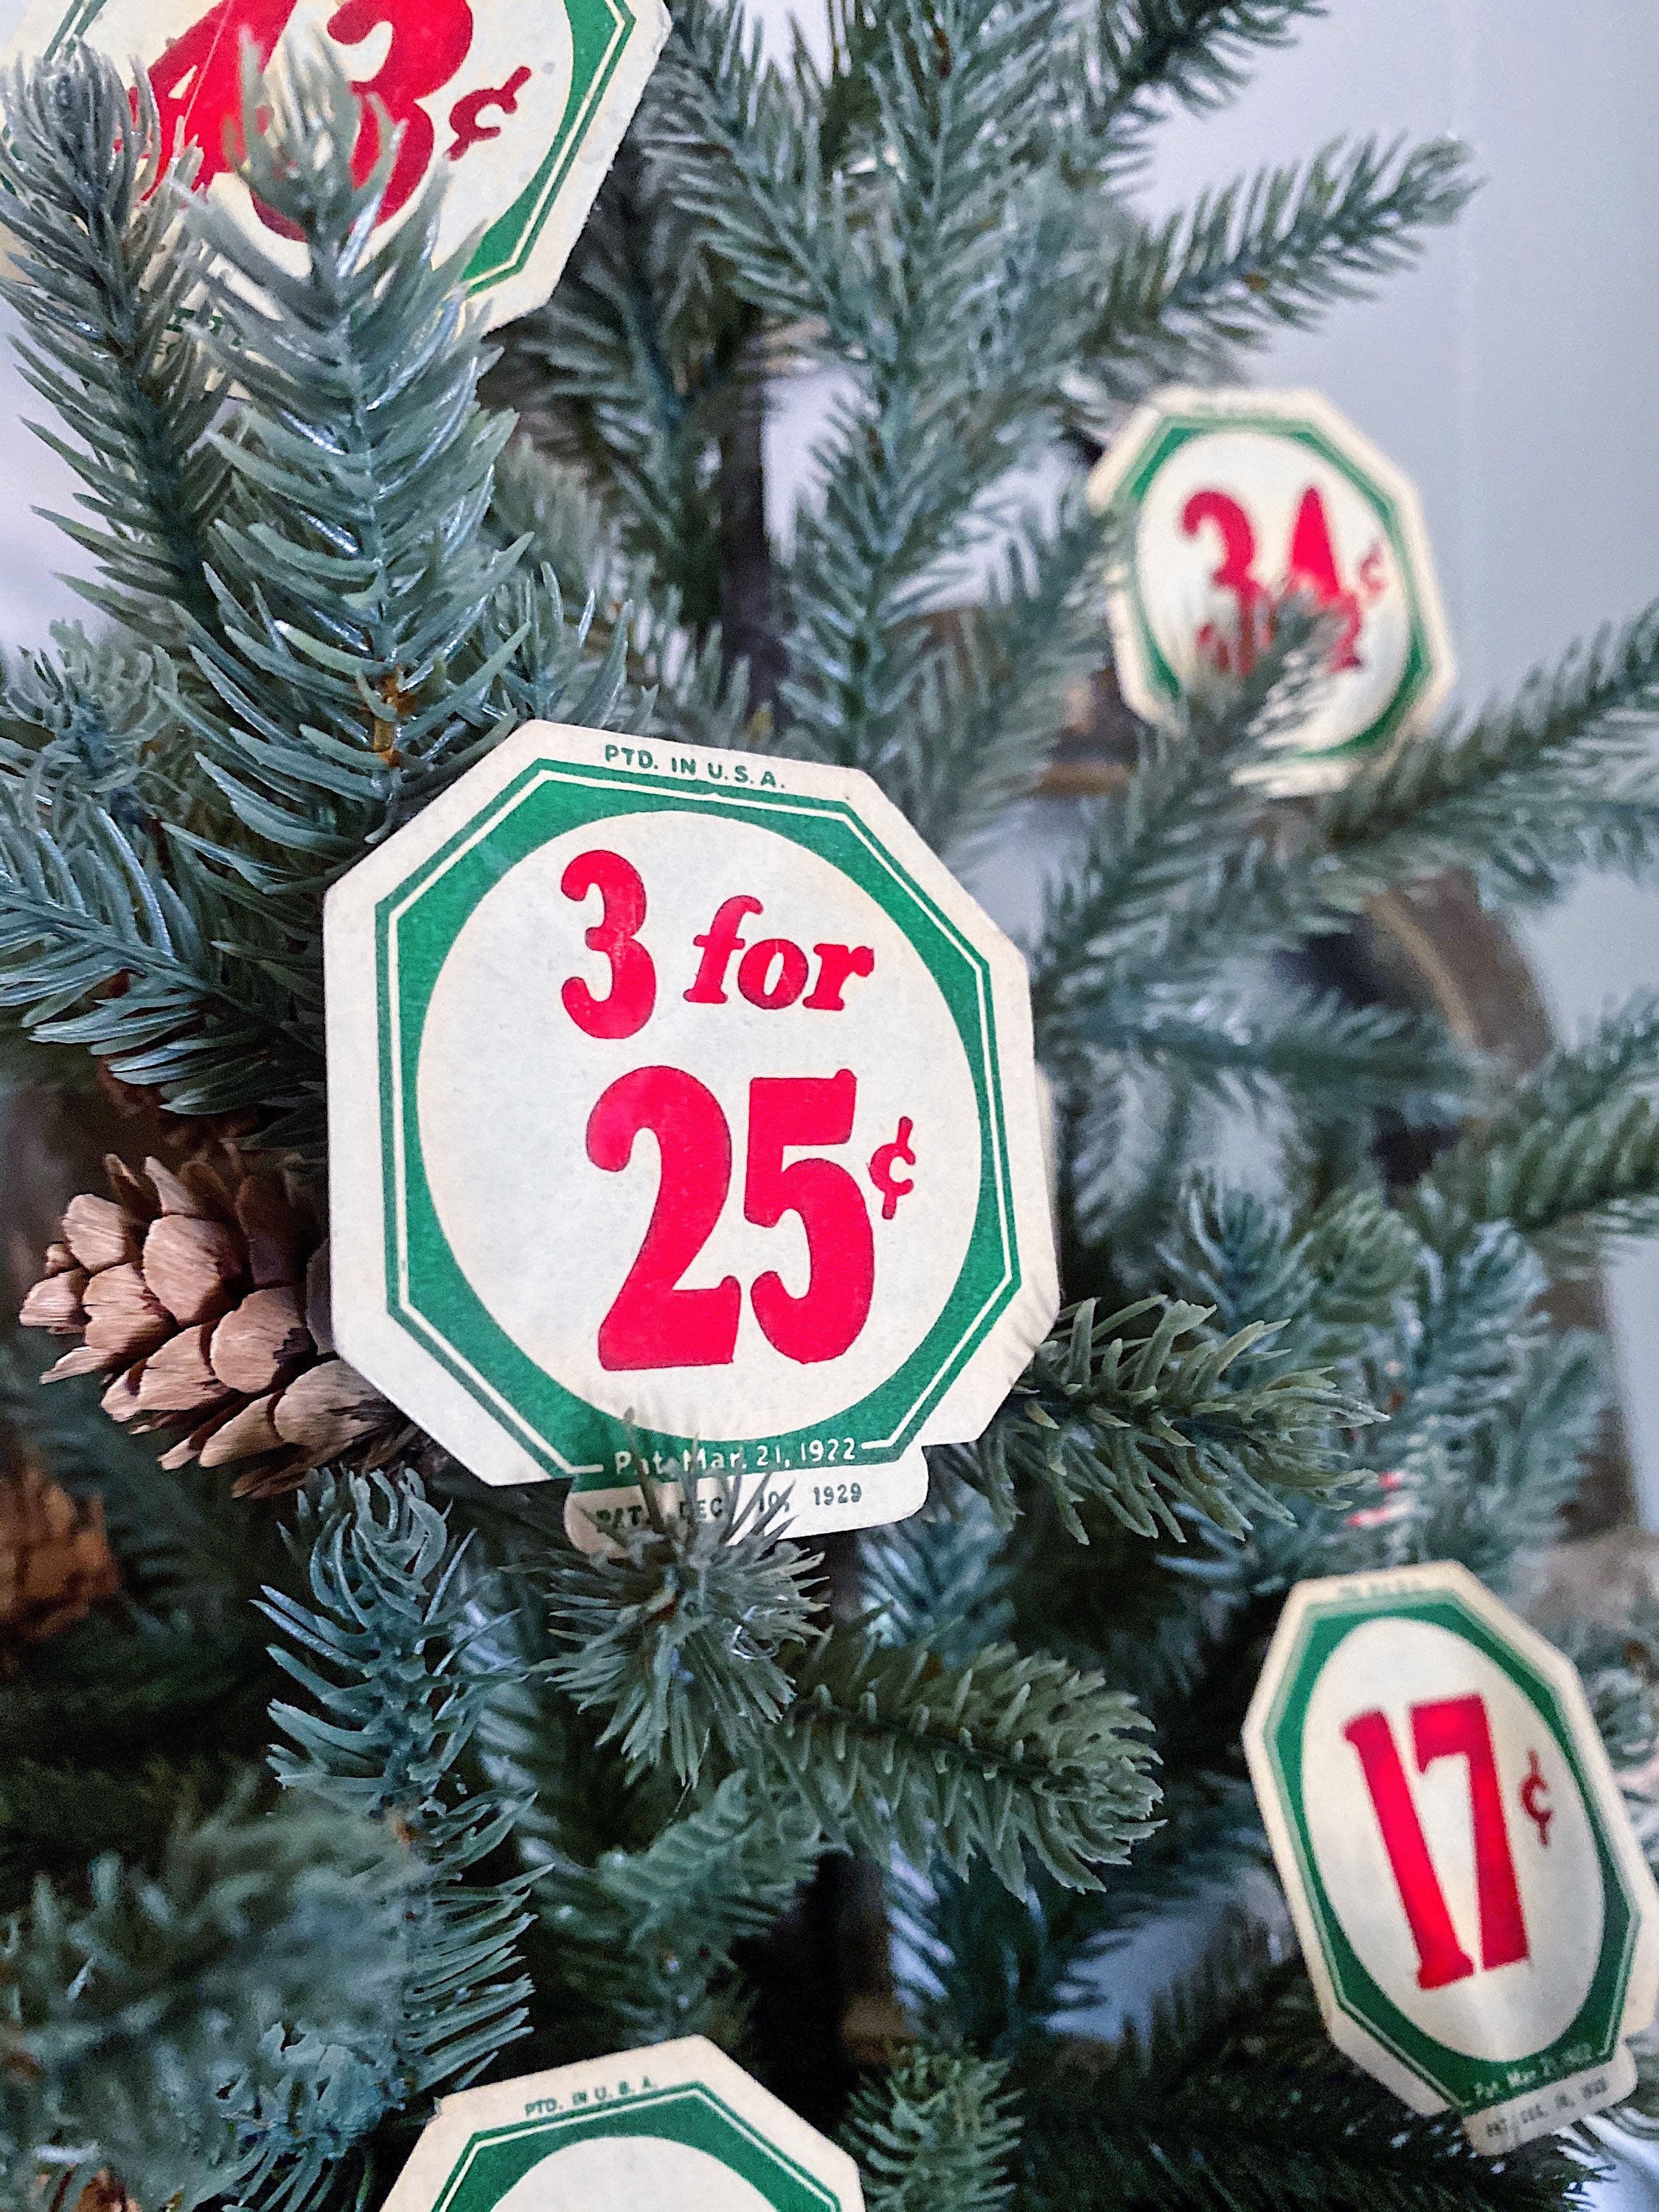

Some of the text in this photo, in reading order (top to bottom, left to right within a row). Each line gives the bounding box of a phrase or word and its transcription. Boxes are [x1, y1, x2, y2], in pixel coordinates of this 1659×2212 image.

[605, 744, 658, 770] PTD.
[671, 757, 696, 776] IN
[561, 849, 874, 1040] 3 for
[586, 1064, 917, 1371] 25¢
[757, 1444, 790, 1468] 21,
[801, 1437, 855, 1462] 1922
[813, 1482, 862, 1506] 1929
[1343, 1691, 1554, 1990] 17¢
[572, 2090, 588, 2105] IN
